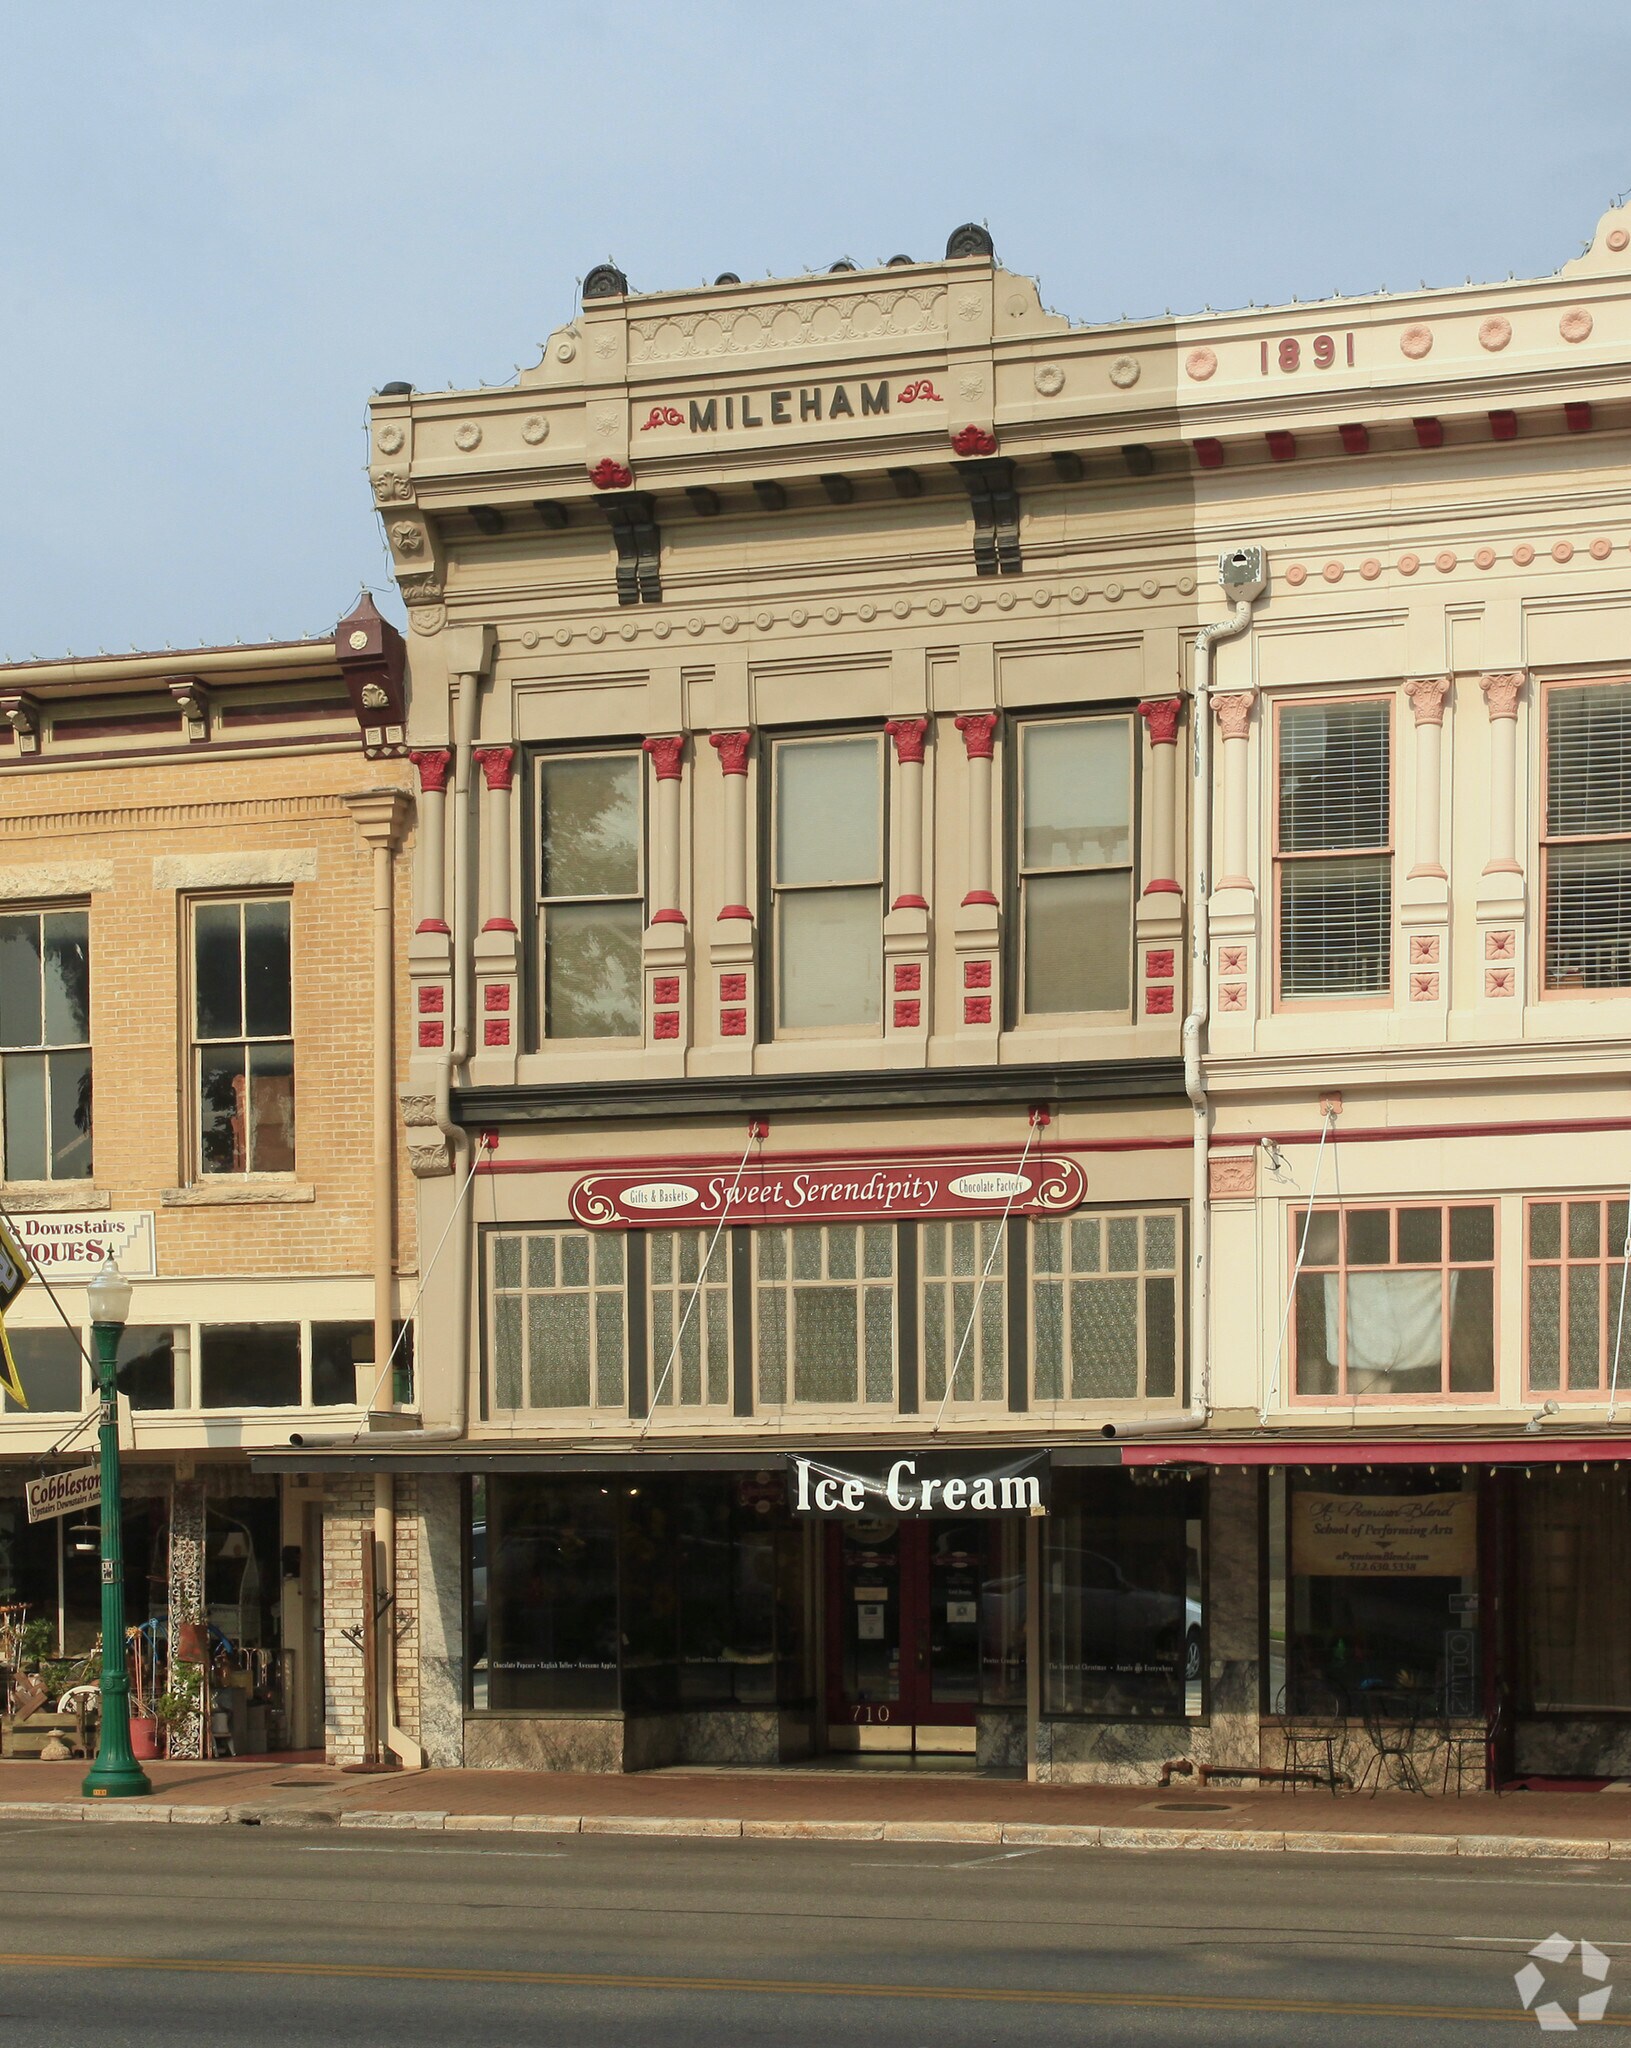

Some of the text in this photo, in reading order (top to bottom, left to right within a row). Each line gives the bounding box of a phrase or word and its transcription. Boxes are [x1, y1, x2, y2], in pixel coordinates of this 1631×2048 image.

[1260, 332, 1355, 375] 1891
[689, 380, 889, 432] MILEHAM
[630, 1188, 689, 1204] Gifts & Baskets
[700, 1172, 939, 1211] Sweet Serendipity
[959, 1177, 1023, 1194] Chocolate Factory
[25, 1219, 126, 1236] Downstairs
[16, 1239, 105, 1266] IQUES
[31, 1473, 101, 1506] Cobbleston
[796, 1460, 1042, 1511] Ice Cream
[31, 1489, 101, 1520] Upstairs Downstairs Anti
[1310, 1500, 1458, 1522] A Premium Blend
[1313, 1523, 1454, 1539] School of Performing Arts
[1450, 1634, 1469, 1712] OPEN
[850, 1704, 890, 1723] 710
